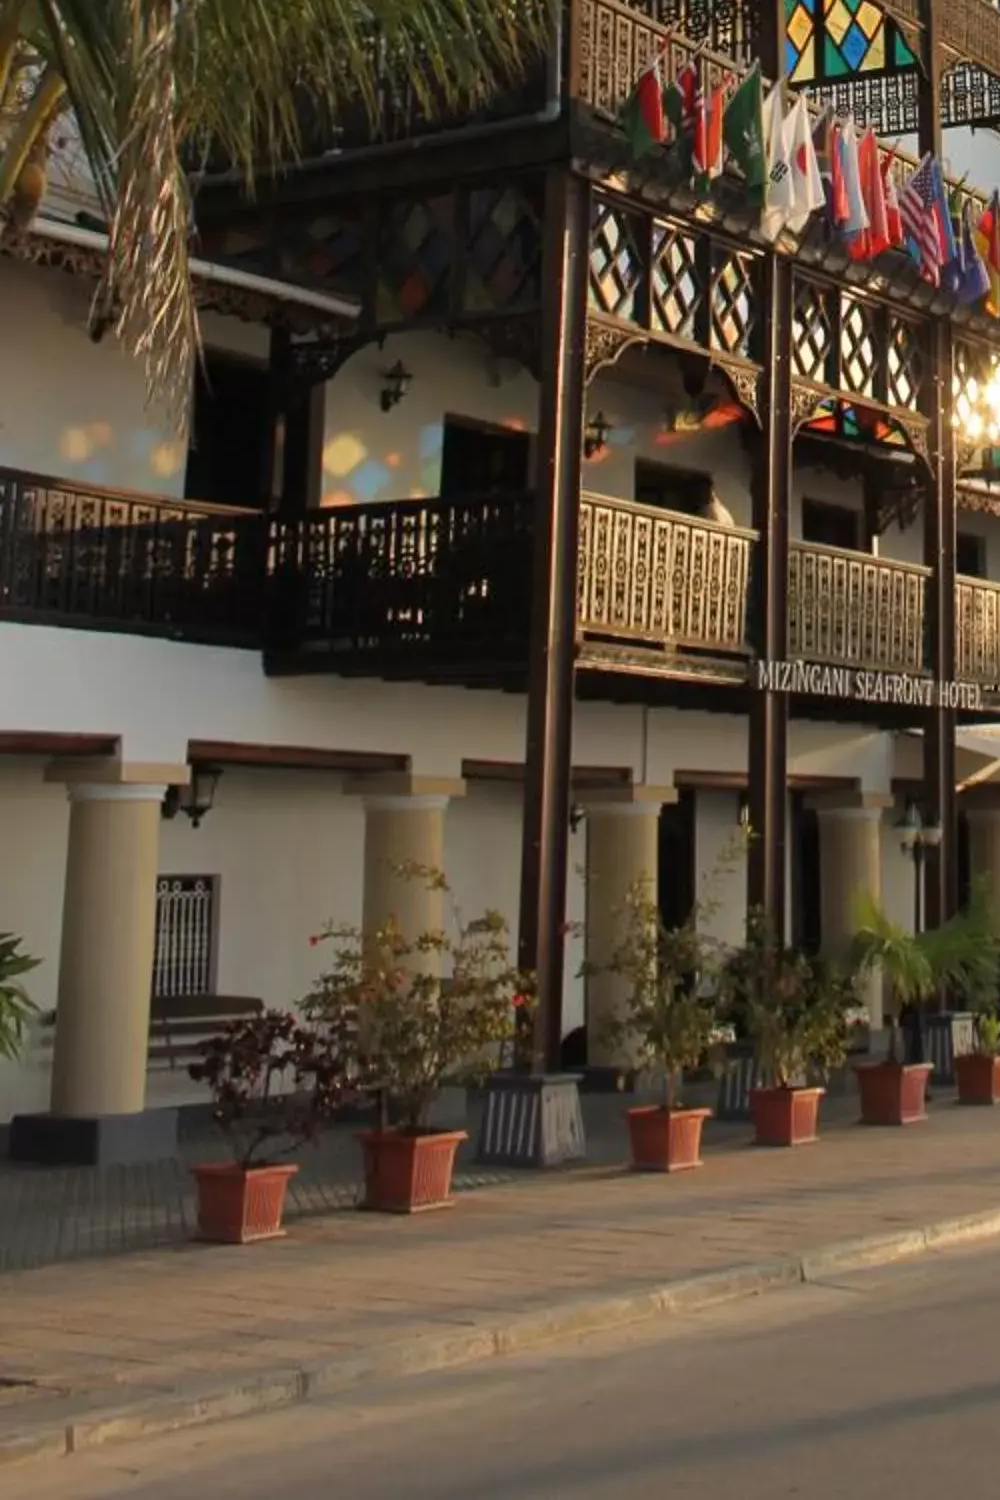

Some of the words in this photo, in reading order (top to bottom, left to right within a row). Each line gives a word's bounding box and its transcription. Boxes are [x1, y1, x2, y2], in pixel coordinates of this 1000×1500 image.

[758, 660, 850, 697] MIZINGANI
[855, 671, 933, 705] SEAFRONT
[939, 681, 983, 710] HOTEL
